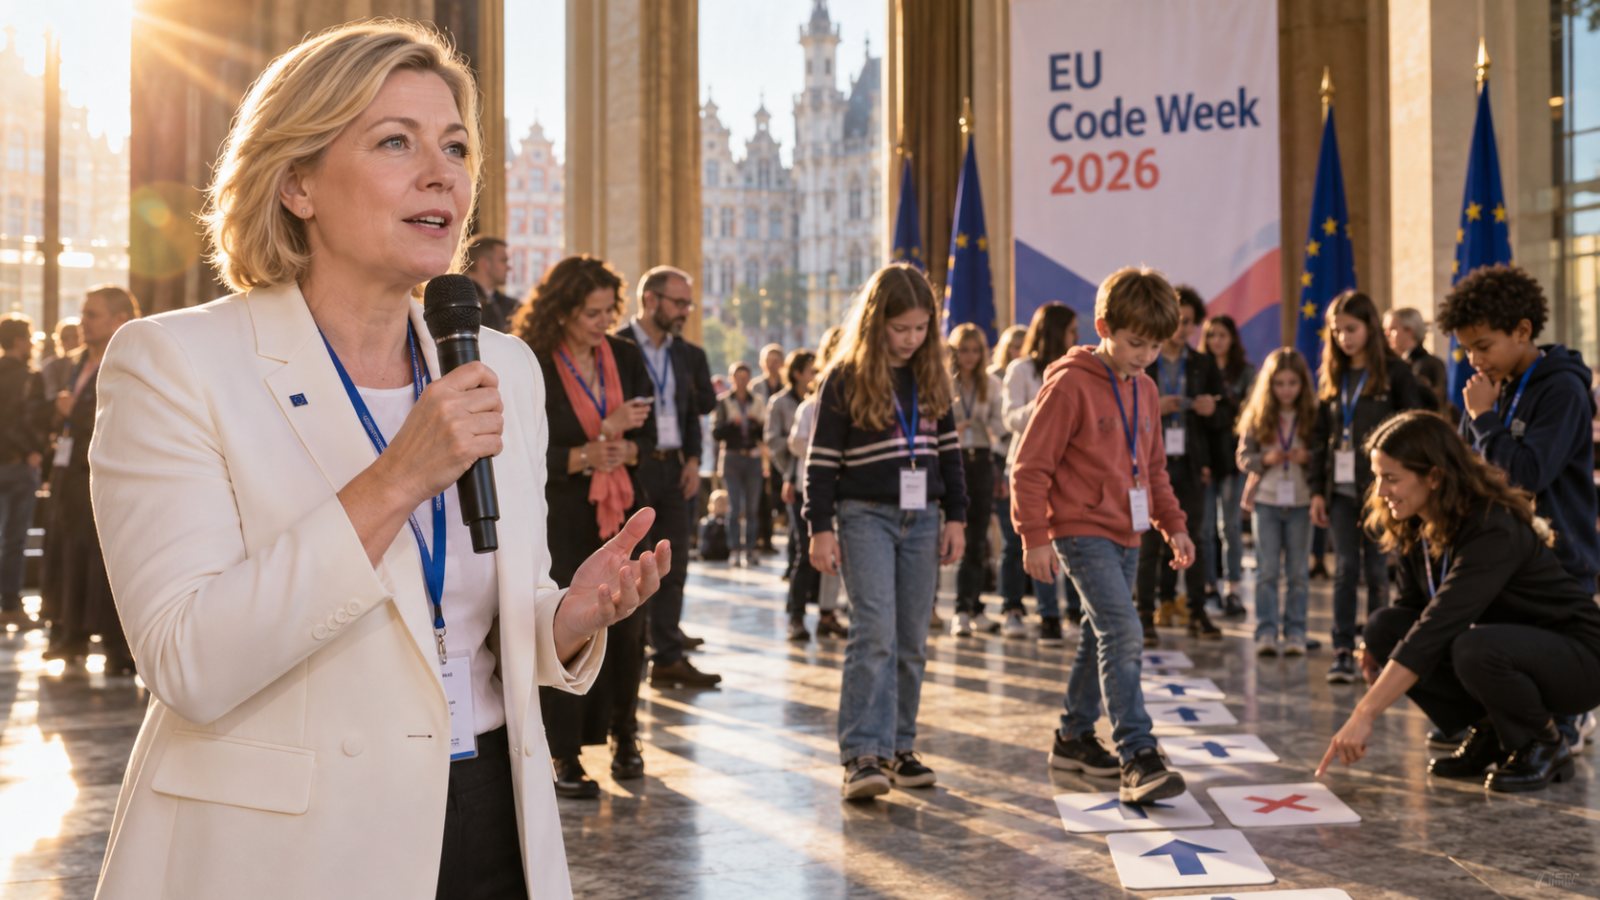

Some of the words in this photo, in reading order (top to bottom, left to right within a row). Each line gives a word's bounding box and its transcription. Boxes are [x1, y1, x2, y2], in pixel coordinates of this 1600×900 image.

[1049, 50, 1102, 92] EU
[1048, 96, 1147, 142] Code
[1155, 86, 1261, 135] Week
[1050, 147, 1160, 195] 2026
